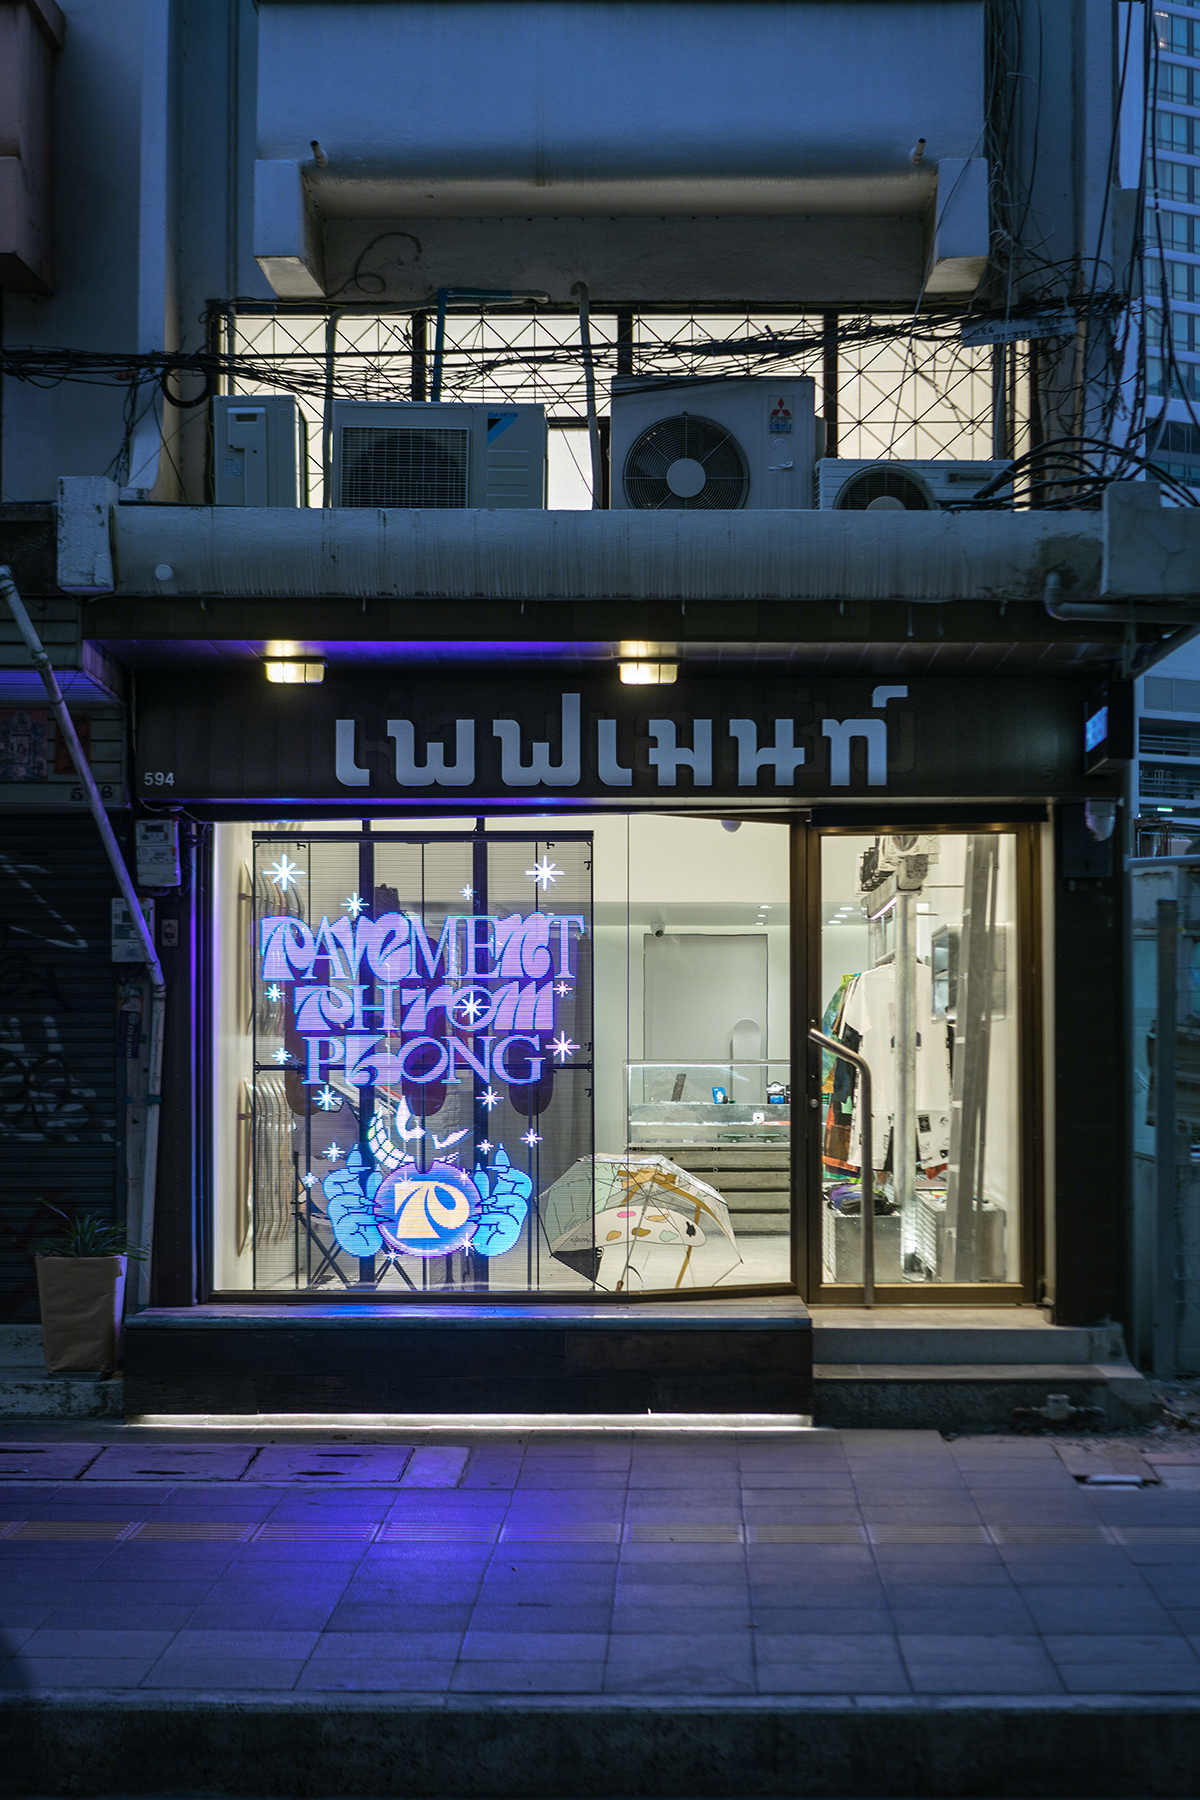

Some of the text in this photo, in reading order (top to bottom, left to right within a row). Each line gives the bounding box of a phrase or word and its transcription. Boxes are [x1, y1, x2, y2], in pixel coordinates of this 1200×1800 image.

[335, 685, 909, 787] เพฟเมนท์
[144, 771, 175, 786] 594
[70, 785, 114, 801] 56
